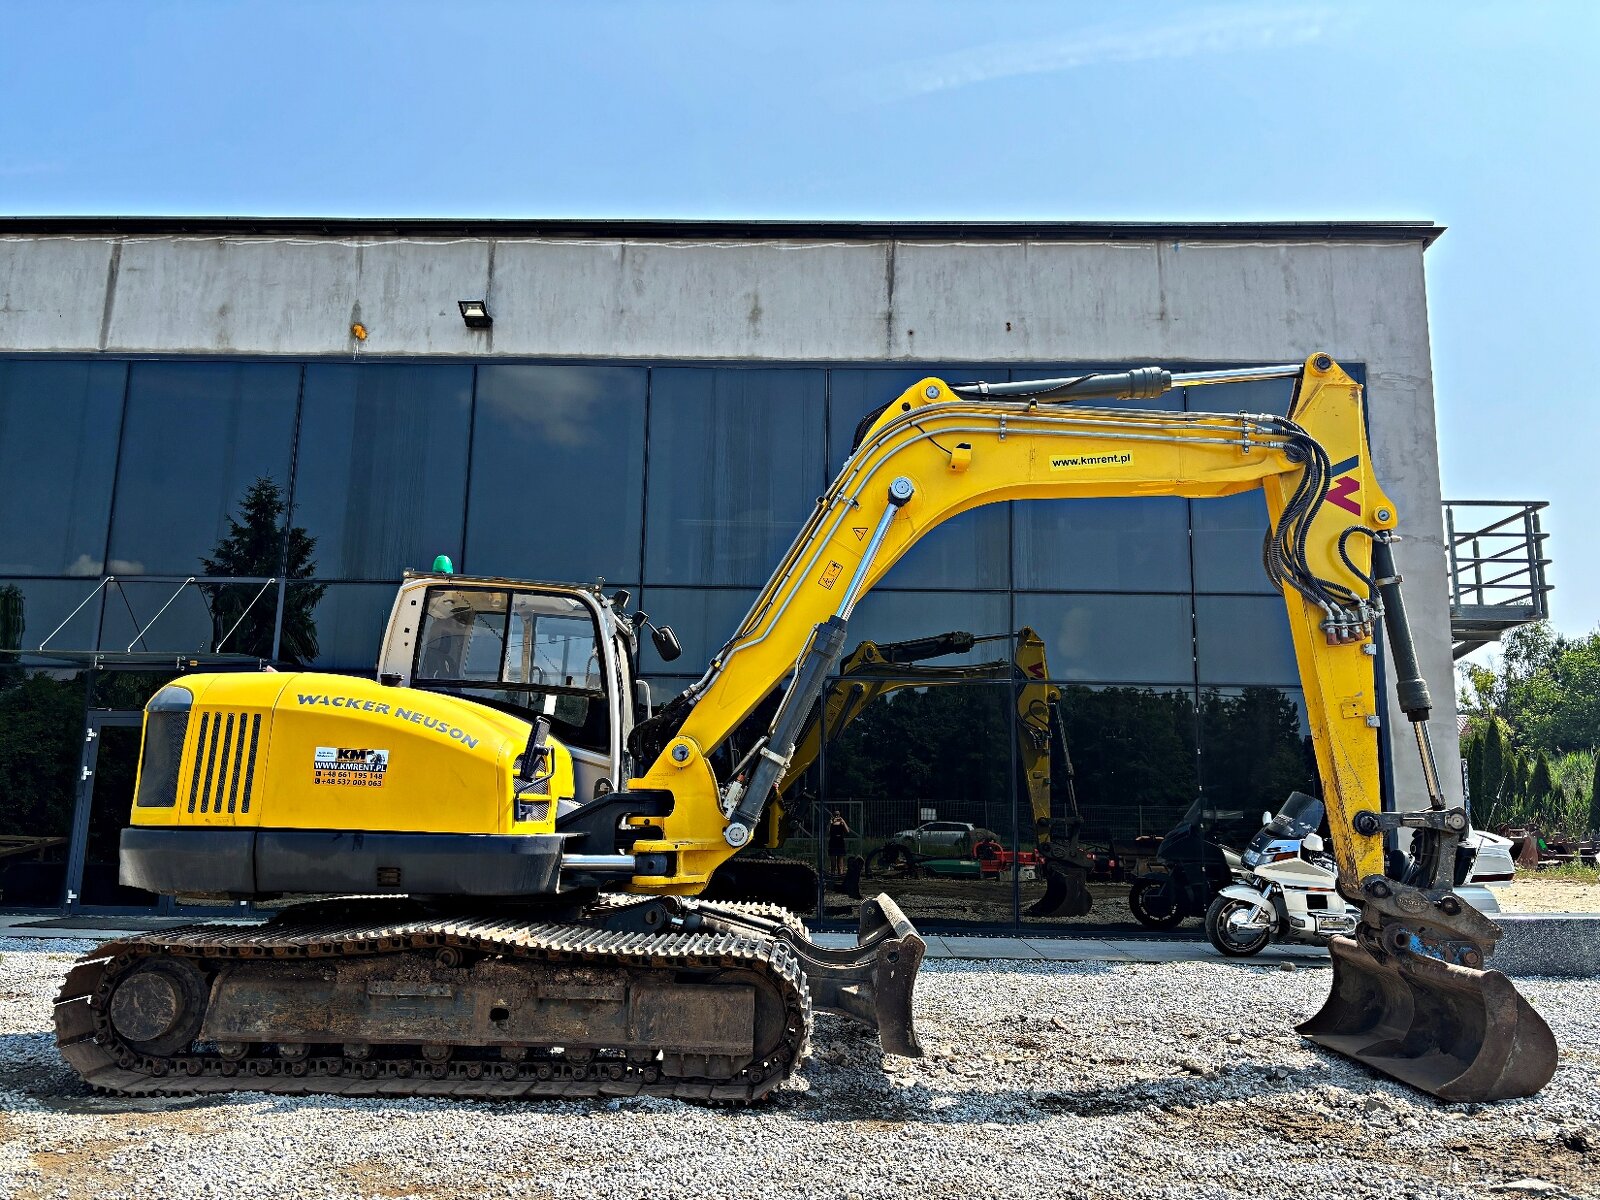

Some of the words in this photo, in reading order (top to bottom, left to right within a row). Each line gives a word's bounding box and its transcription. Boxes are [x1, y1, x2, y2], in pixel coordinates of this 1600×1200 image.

[1052, 453, 1131, 467] www.kmrent.pl
[297, 694, 390, 714] WACKER
[394, 707, 479, 749] NEUSON
[338, 749, 366, 760] KM
[314, 761, 386, 772] WWW.KMRENT.PL
[337, 778, 351, 786] 537
